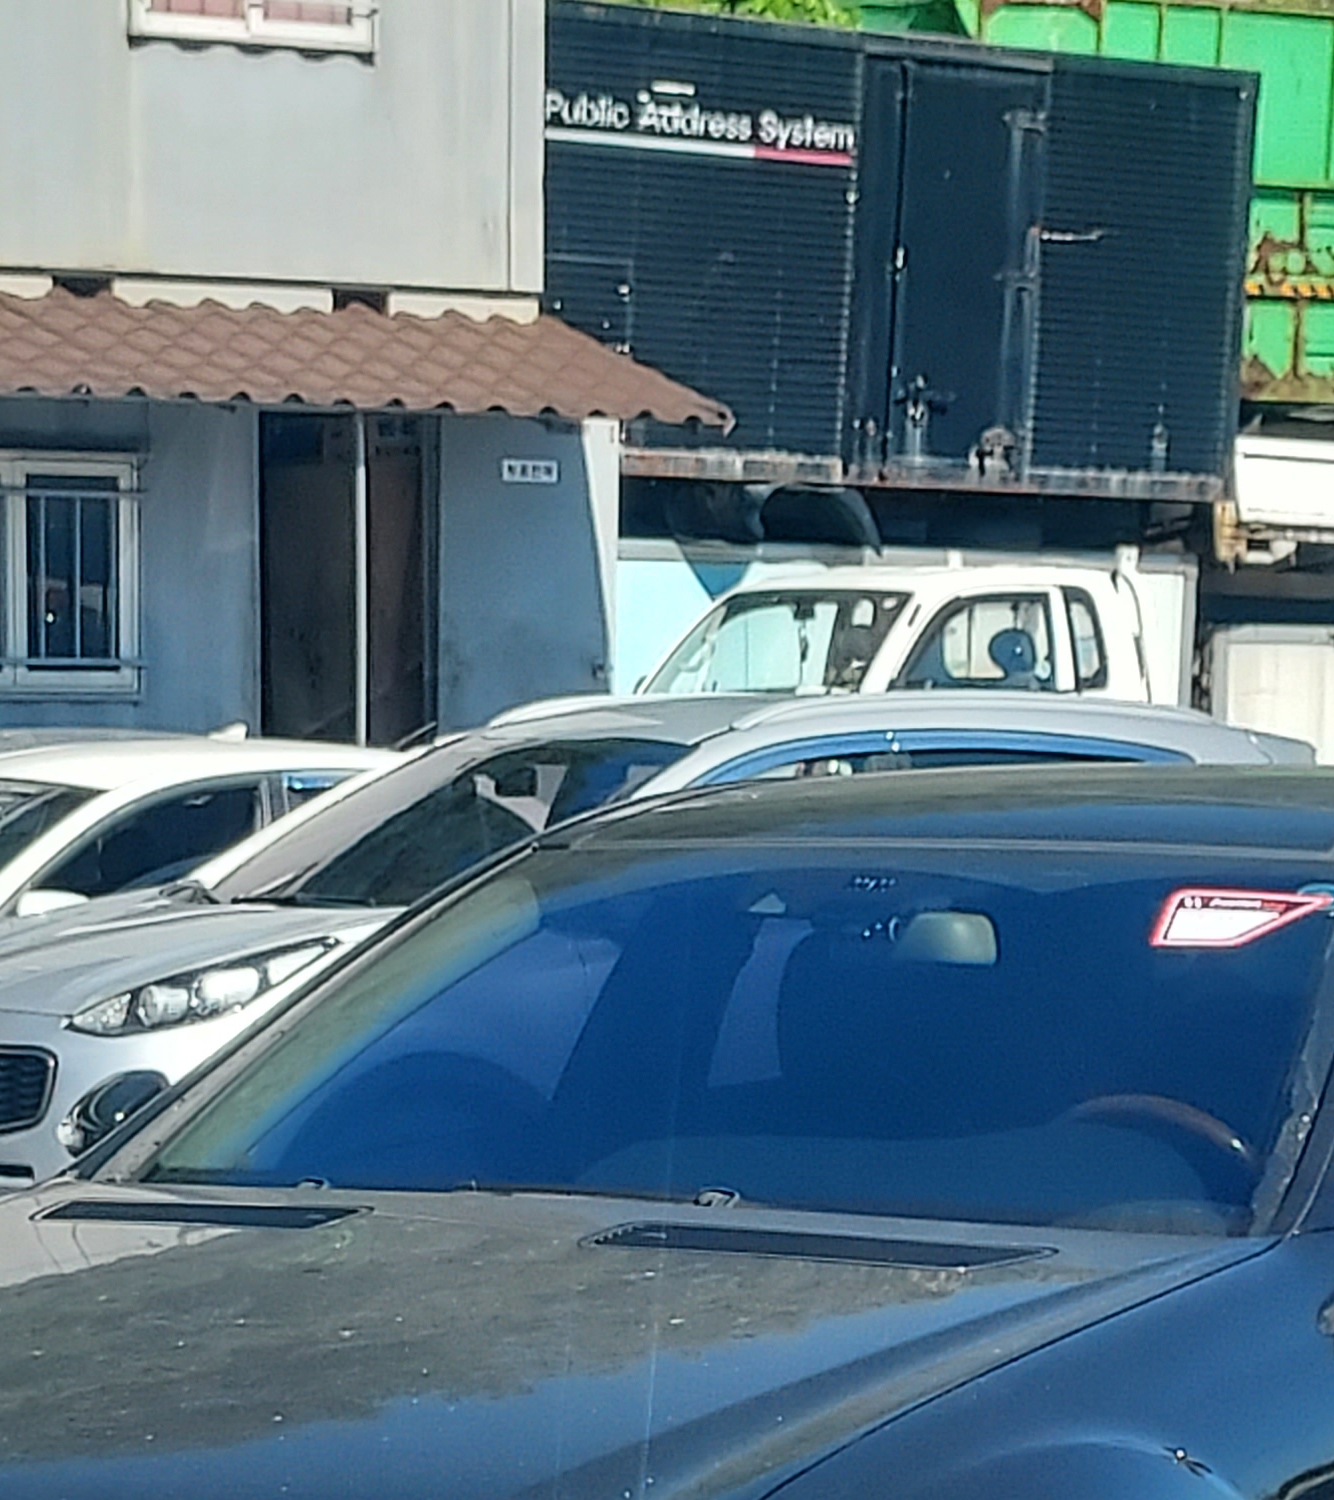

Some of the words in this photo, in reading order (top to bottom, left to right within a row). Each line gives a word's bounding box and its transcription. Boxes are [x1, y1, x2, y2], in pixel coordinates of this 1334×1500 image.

[546, 88, 630, 129] Public
[638, 100, 752, 142] Address
[759, 109, 855, 150] System
